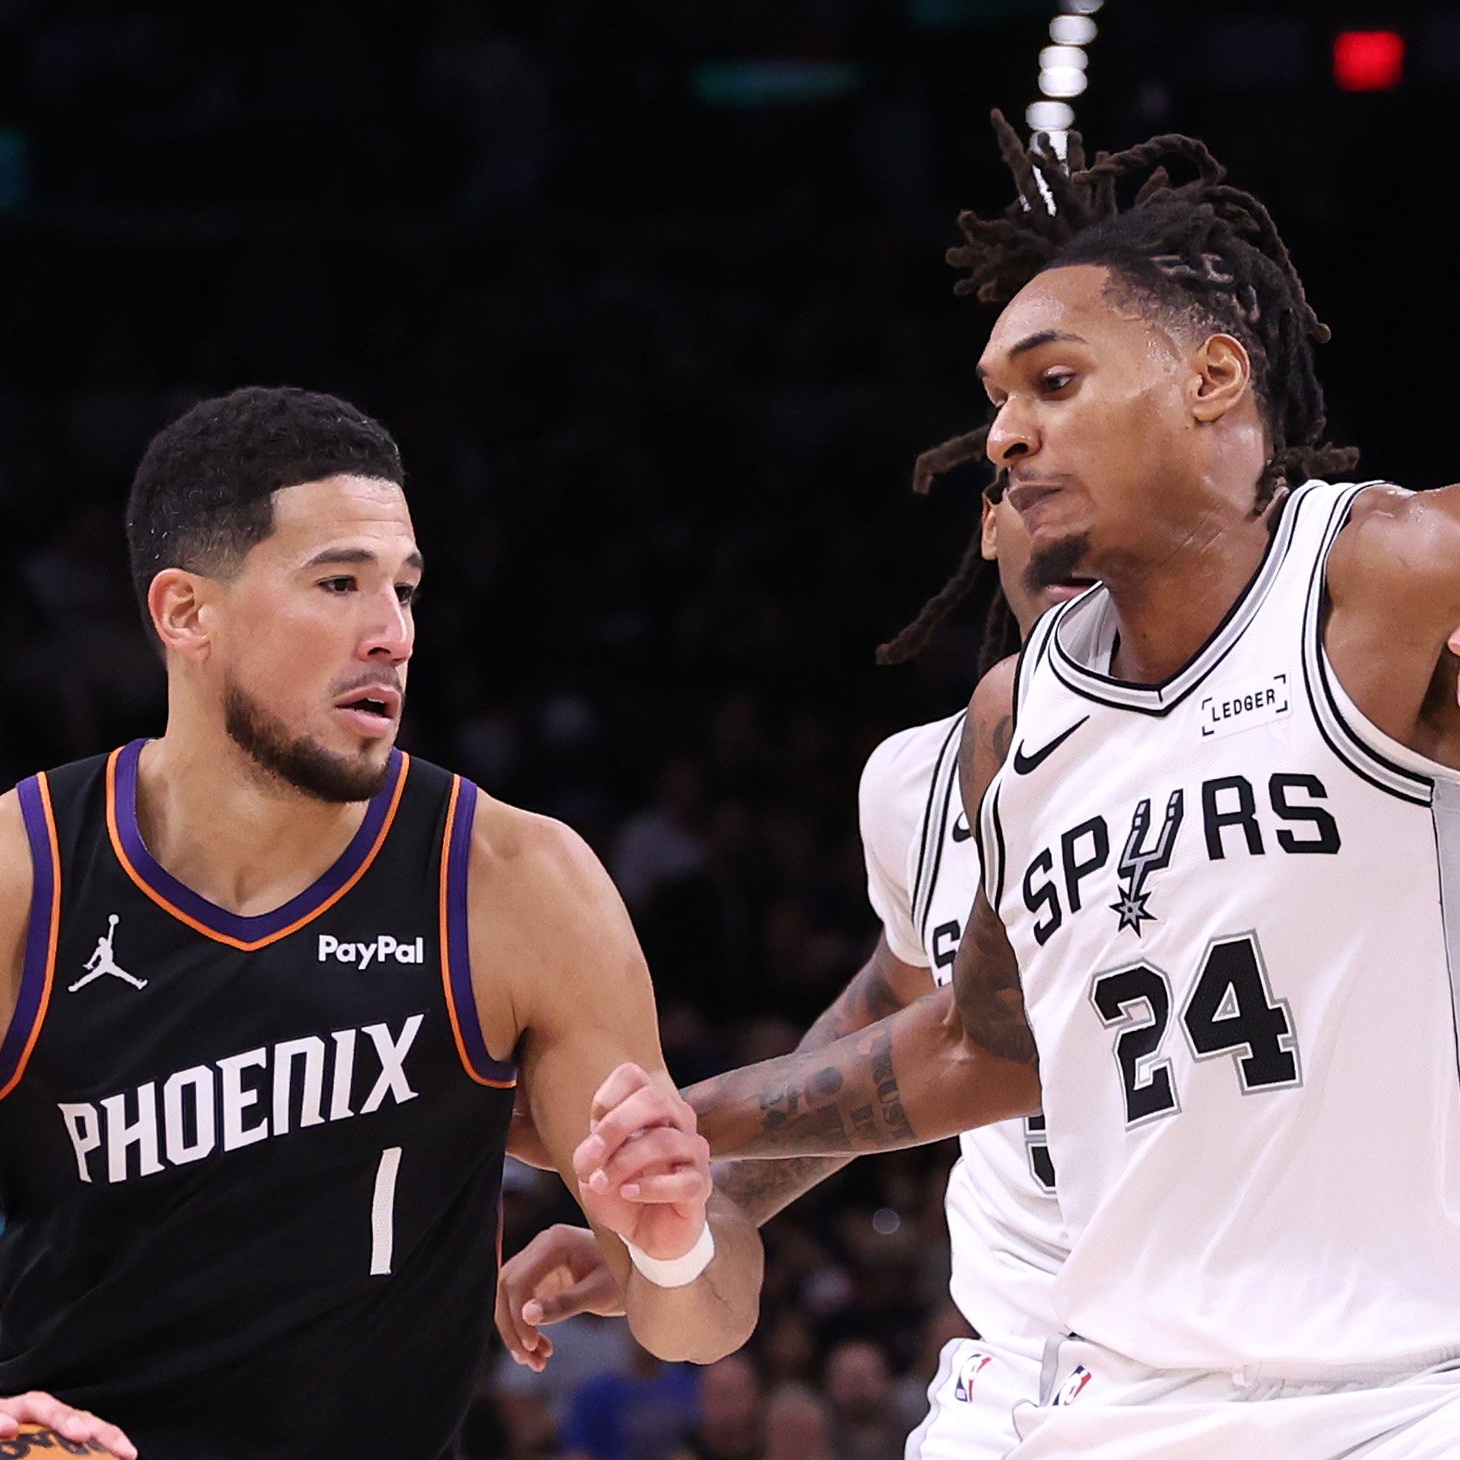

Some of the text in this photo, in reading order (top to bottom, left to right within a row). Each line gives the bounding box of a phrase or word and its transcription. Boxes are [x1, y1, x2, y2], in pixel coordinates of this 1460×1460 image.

[1212, 688, 1276, 722] LEDGER
[1022, 772, 1342, 947] SPURS
[319, 934, 424, 970] PayPal
[57, 1013, 425, 1184] PHOENIX
[1088, 930, 1304, 1132] 24
[370, 1147, 403, 1276] 1
